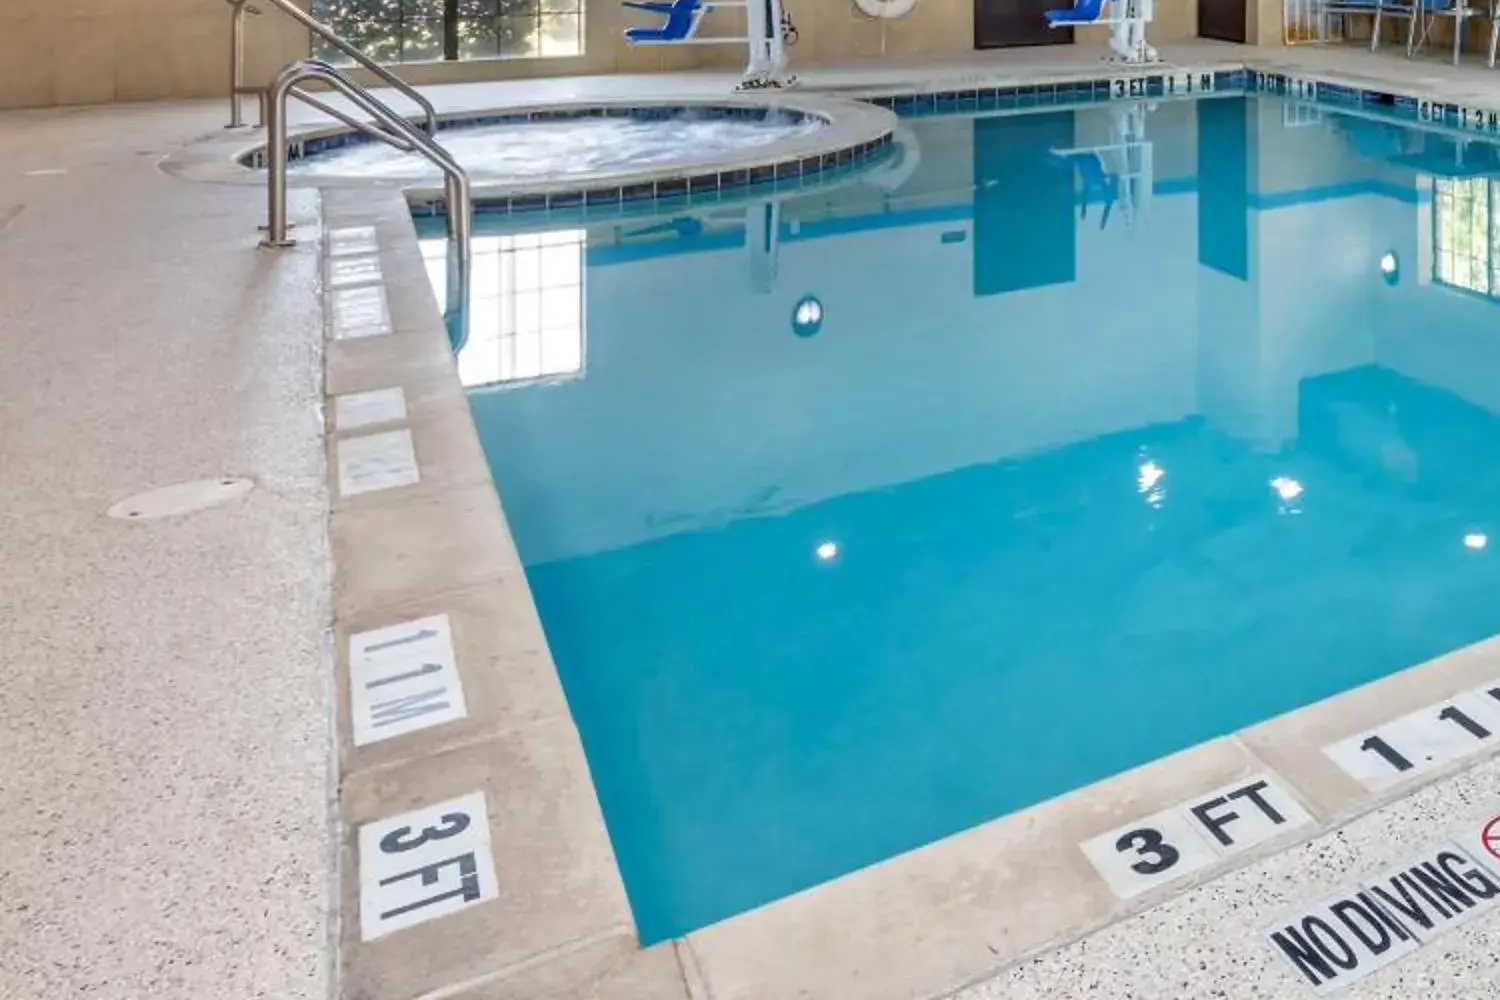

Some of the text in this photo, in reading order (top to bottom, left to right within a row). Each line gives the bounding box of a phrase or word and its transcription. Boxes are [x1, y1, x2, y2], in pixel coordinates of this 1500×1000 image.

[369, 688, 450, 728] M
[379, 812, 481, 920] 3 FT
[1115, 780, 1287, 875] 3 FT
[1270, 914, 1358, 987] NO
